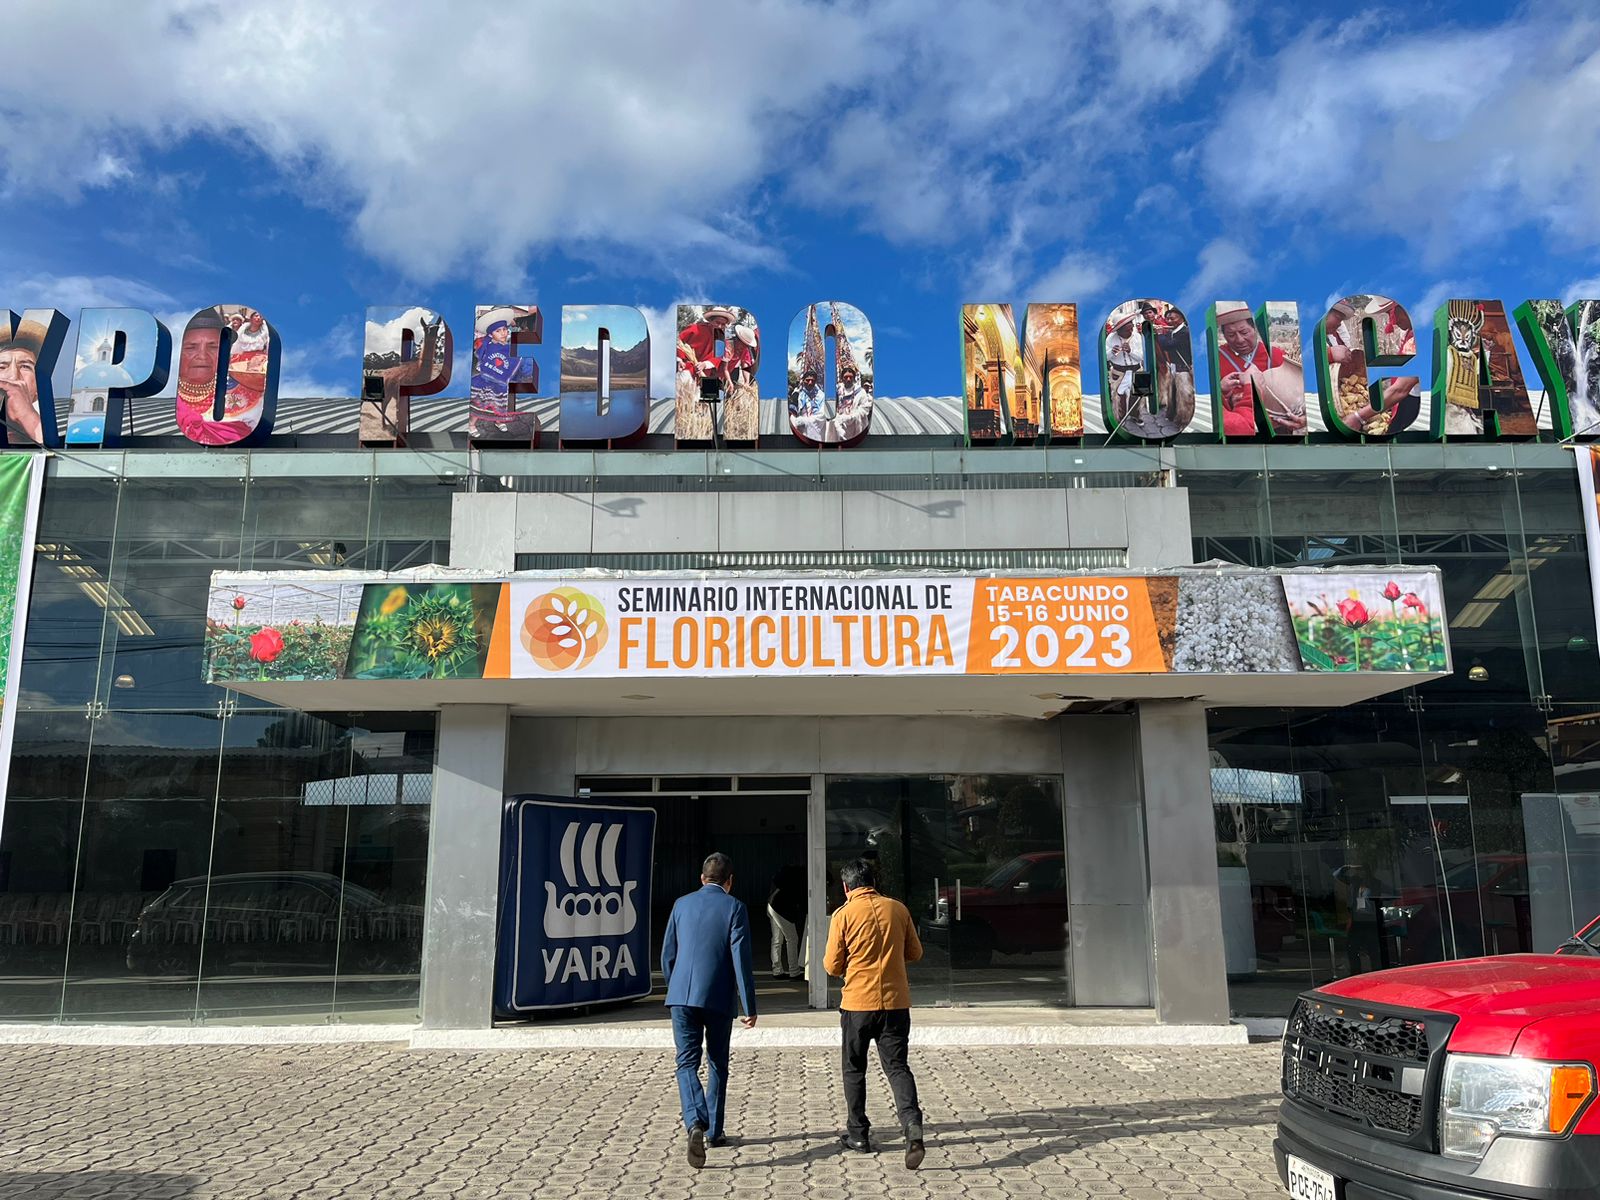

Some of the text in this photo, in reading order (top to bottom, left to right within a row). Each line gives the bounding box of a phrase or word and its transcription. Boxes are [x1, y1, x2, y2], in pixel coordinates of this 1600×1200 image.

[359, 301, 874, 445] PEDRO
[618, 584, 952, 612] SEMINARIO INTERNACIONAL DE
[985, 585, 1129, 602] TABACUNDO
[986, 604, 1129, 622] 15-16 JUNIO
[618, 614, 954, 669] FLORICULTURA
[989, 624, 1133, 668] 2023
[541, 943, 637, 984] YARA
